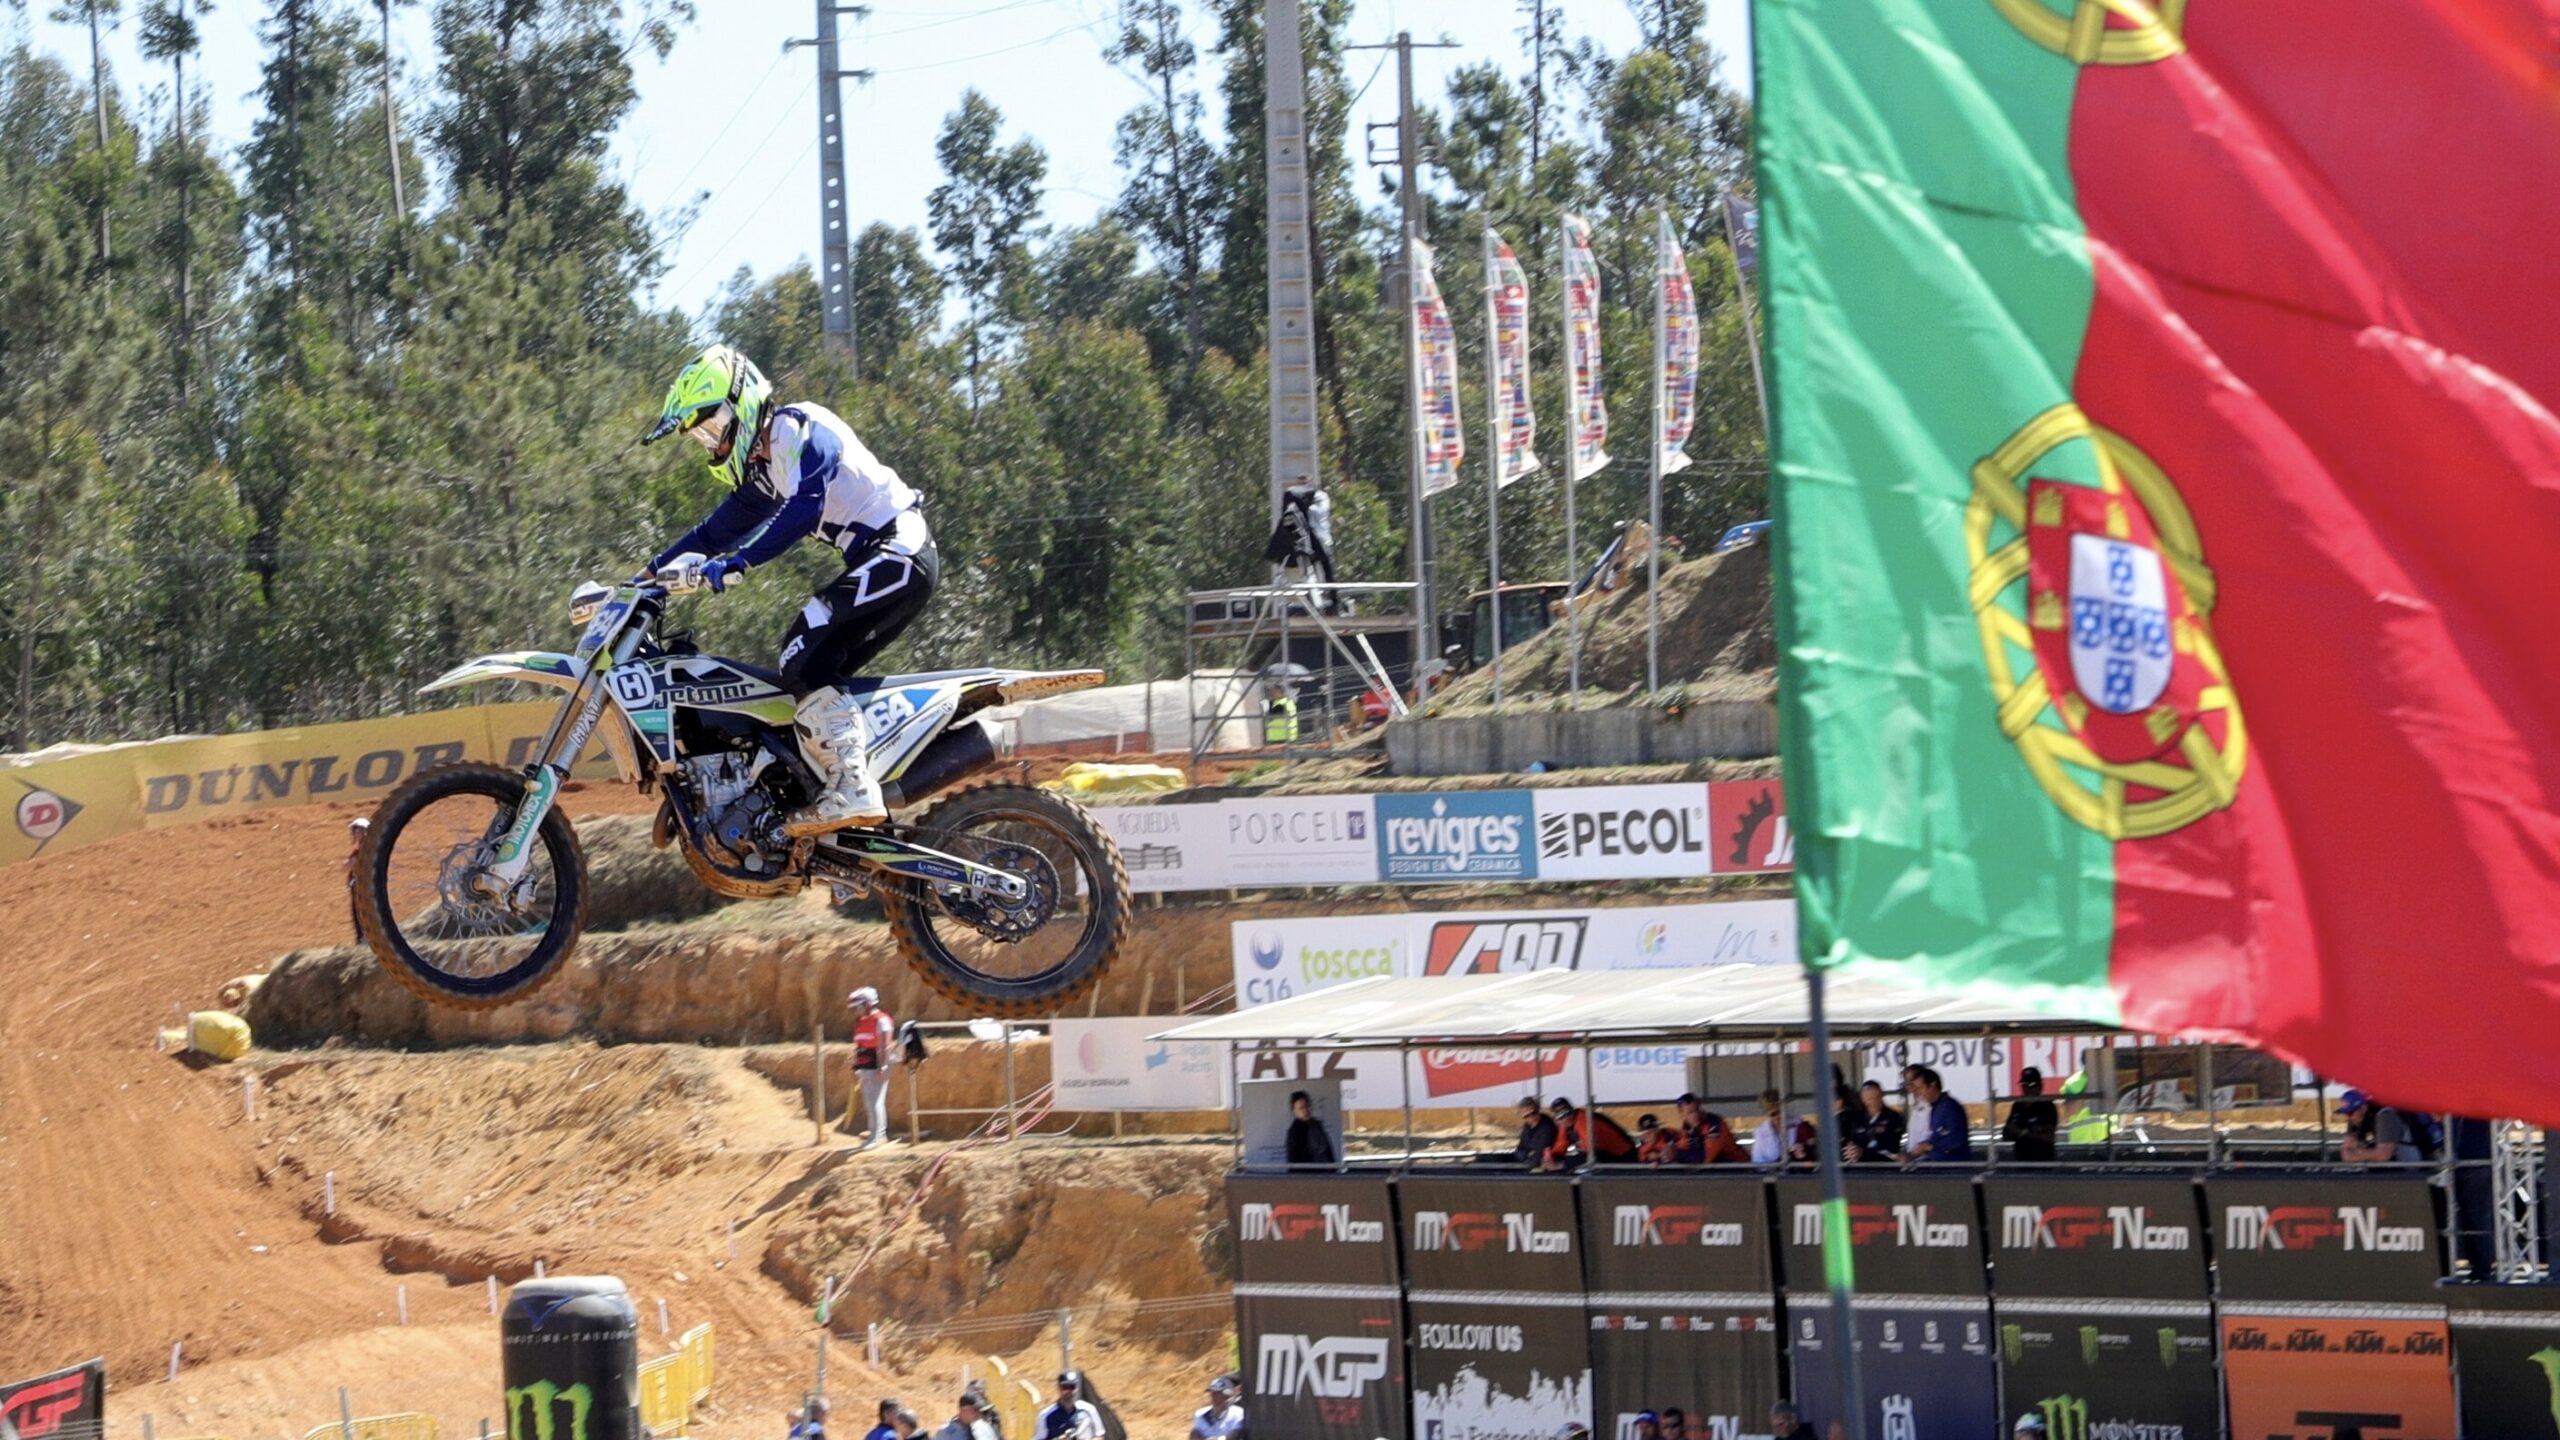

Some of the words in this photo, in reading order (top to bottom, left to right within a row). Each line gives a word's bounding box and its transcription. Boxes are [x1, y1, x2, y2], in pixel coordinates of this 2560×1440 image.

[1228, 811, 1345, 845] PORCEL
[1386, 797, 1520, 871] revigres
[1572, 808, 1702, 857] PECOL
[1300, 944, 1392, 984] toscca
[1246, 976, 1292, 1003] C16
[1615, 1048, 1688, 1066] BOGE
[1495, 1325, 1523, 1352] US
[1256, 1334, 1389, 1405] MXGP
